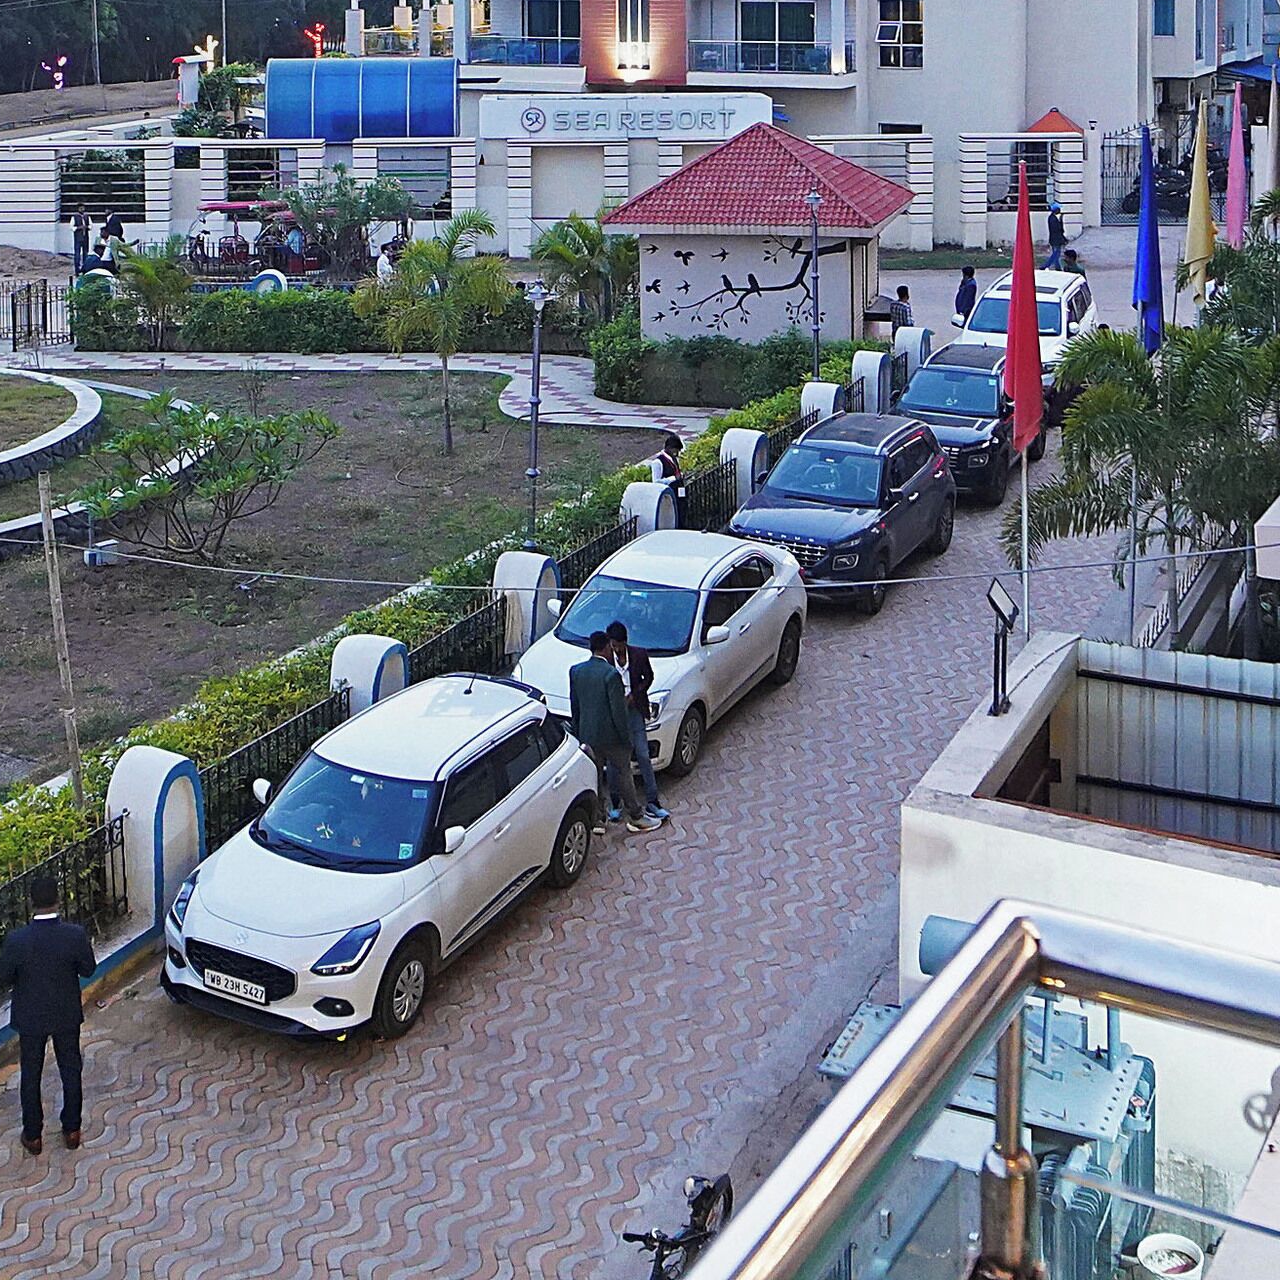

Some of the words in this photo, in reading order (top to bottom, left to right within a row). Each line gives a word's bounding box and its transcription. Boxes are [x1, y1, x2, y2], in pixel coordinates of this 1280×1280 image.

[553, 109, 611, 131] SEA
[617, 108, 736, 131] RESORT
[210, 974, 222, 986] WB
[224, 977, 241, 992] 23H
